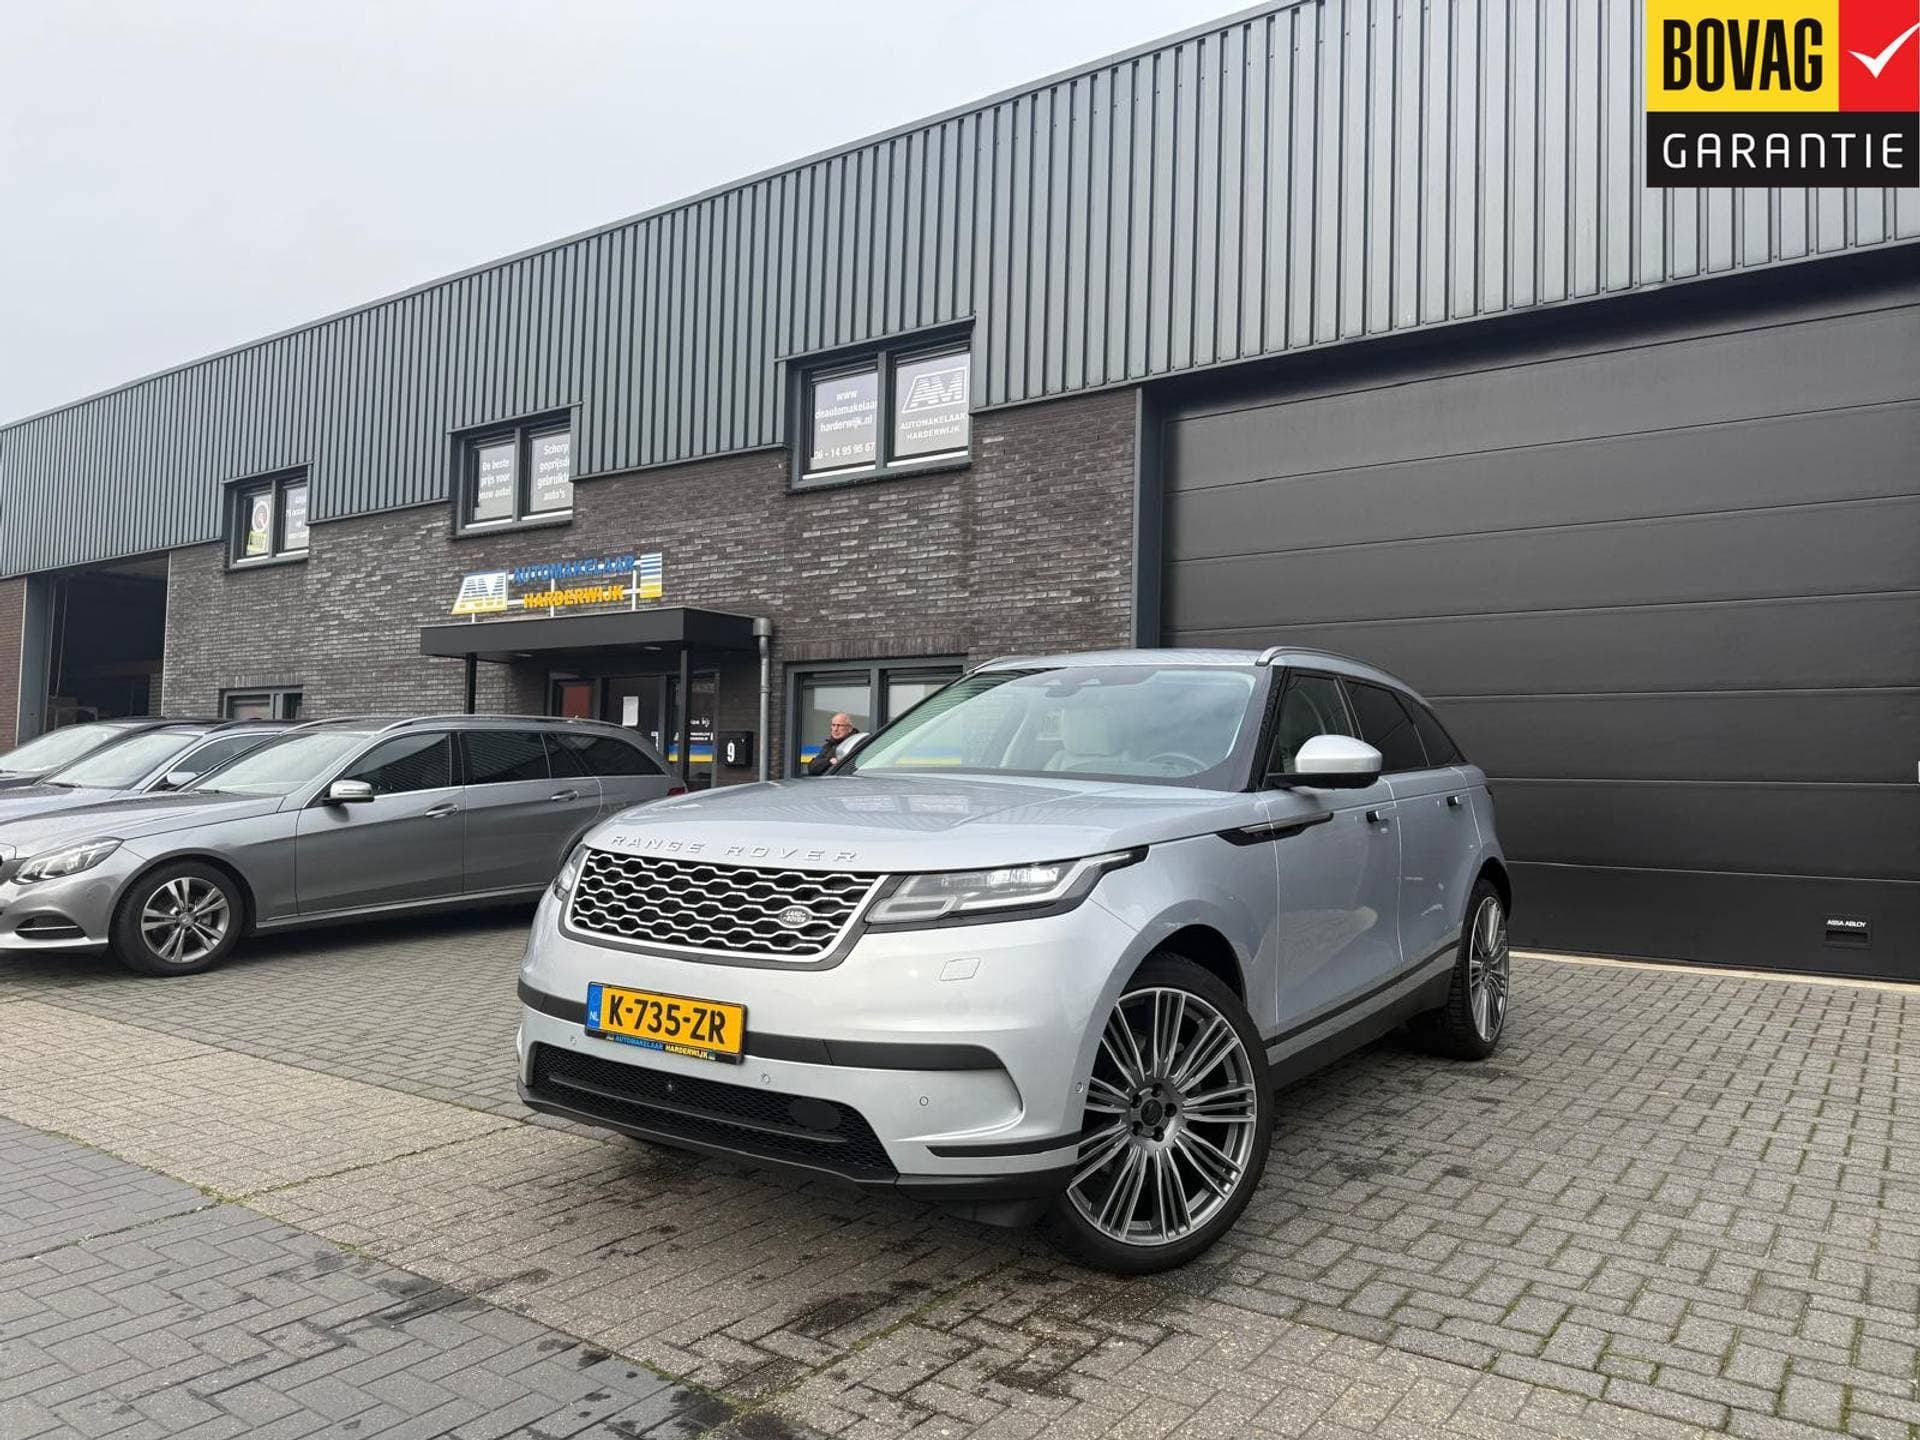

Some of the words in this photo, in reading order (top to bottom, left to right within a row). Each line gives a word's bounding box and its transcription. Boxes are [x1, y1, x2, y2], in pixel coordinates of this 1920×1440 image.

[906, 425, 961, 441] HARDERWIJK
[513, 555, 635, 585] AUTOMAKELAAR
[522, 584, 625, 609] HARDERWIJK
[727, 742, 735, 763] 9
[610, 836, 706, 854] RANGE
[723, 846, 857, 862] ROVER
[589, 1011, 599, 1022] NL
[609, 994, 726, 1045] K-735-ZR
[665, 1045, 709, 1060] HARDERWIJK
